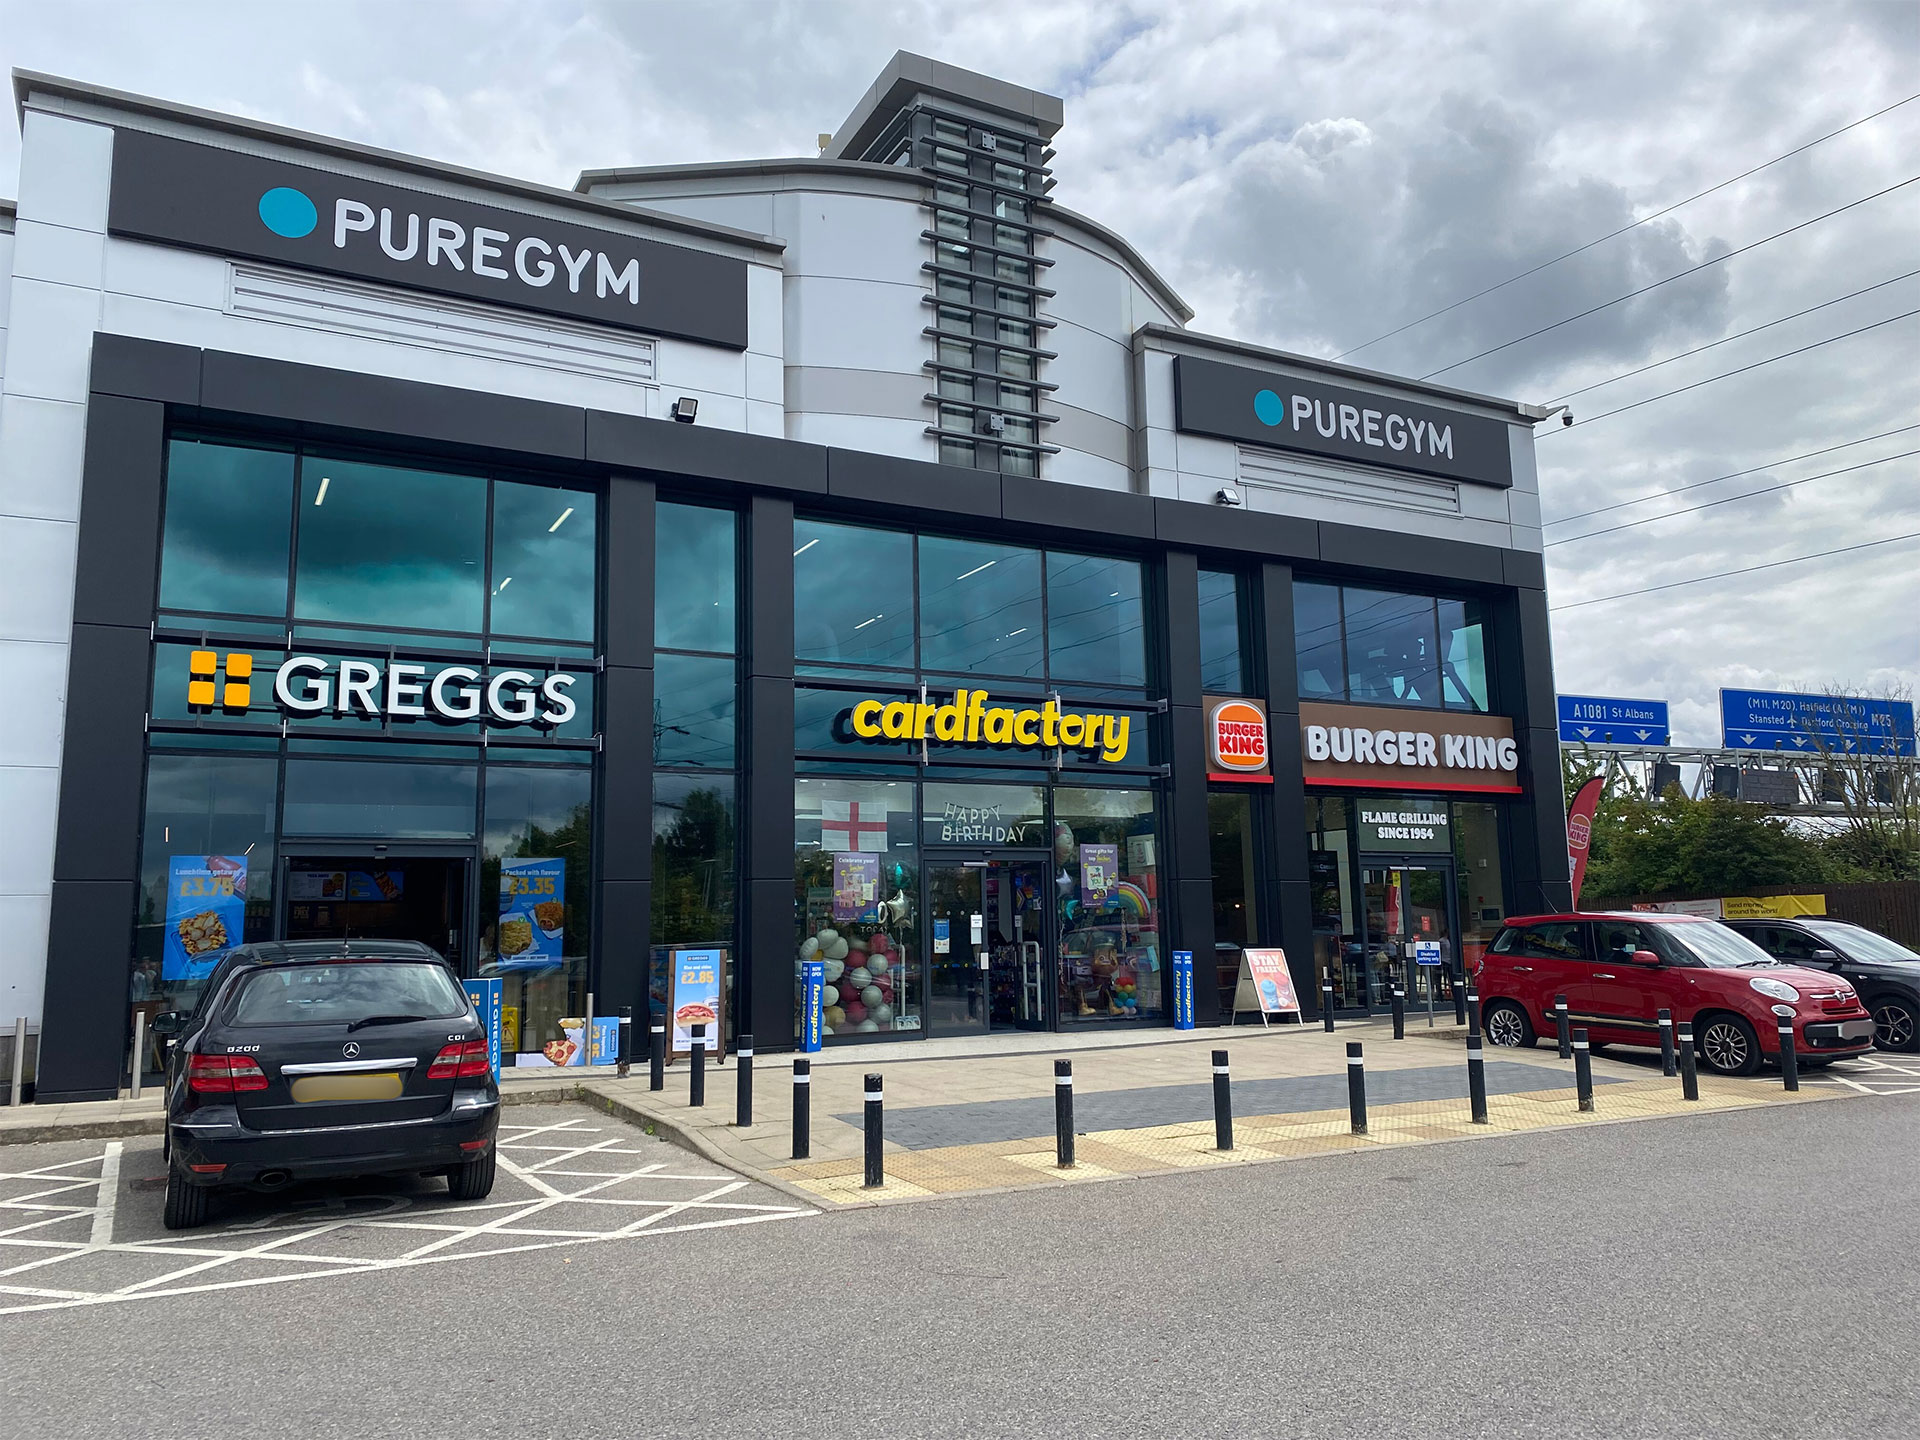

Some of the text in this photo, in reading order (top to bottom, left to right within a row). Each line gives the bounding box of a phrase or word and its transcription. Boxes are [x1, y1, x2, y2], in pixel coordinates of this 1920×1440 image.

[333, 197, 640, 306] PUREGYM
[1291, 394, 1455, 460] PUREGYM
[275, 655, 577, 724] GREGGS
[1574, 703, 1655, 720] A1081 St Albans
[1749, 713, 1785, 725] Stansted
[852, 688, 1130, 763] cardfactory
[1217, 722, 1264, 738] BURGER
[1219, 735, 1265, 755] KING
[1304, 725, 1519, 771] BURGER KING
[944, 802, 1001, 823] HAPPY
[1361, 811, 1448, 826] FLAME GRILLING
[941, 825, 1026, 842] BIRTHDAY
[1377, 826, 1434, 840] SINCE 1954
[1570, 829, 1588, 843] KING
[181, 877, 235, 897] £3.75
[509, 877, 555, 895] £3.35
[1252, 955, 1280, 966] STAY
[681, 970, 714, 985] £2.85
[811, 983, 821, 1045] cardfactory
[491, 1008, 499, 1073] GREGGS
